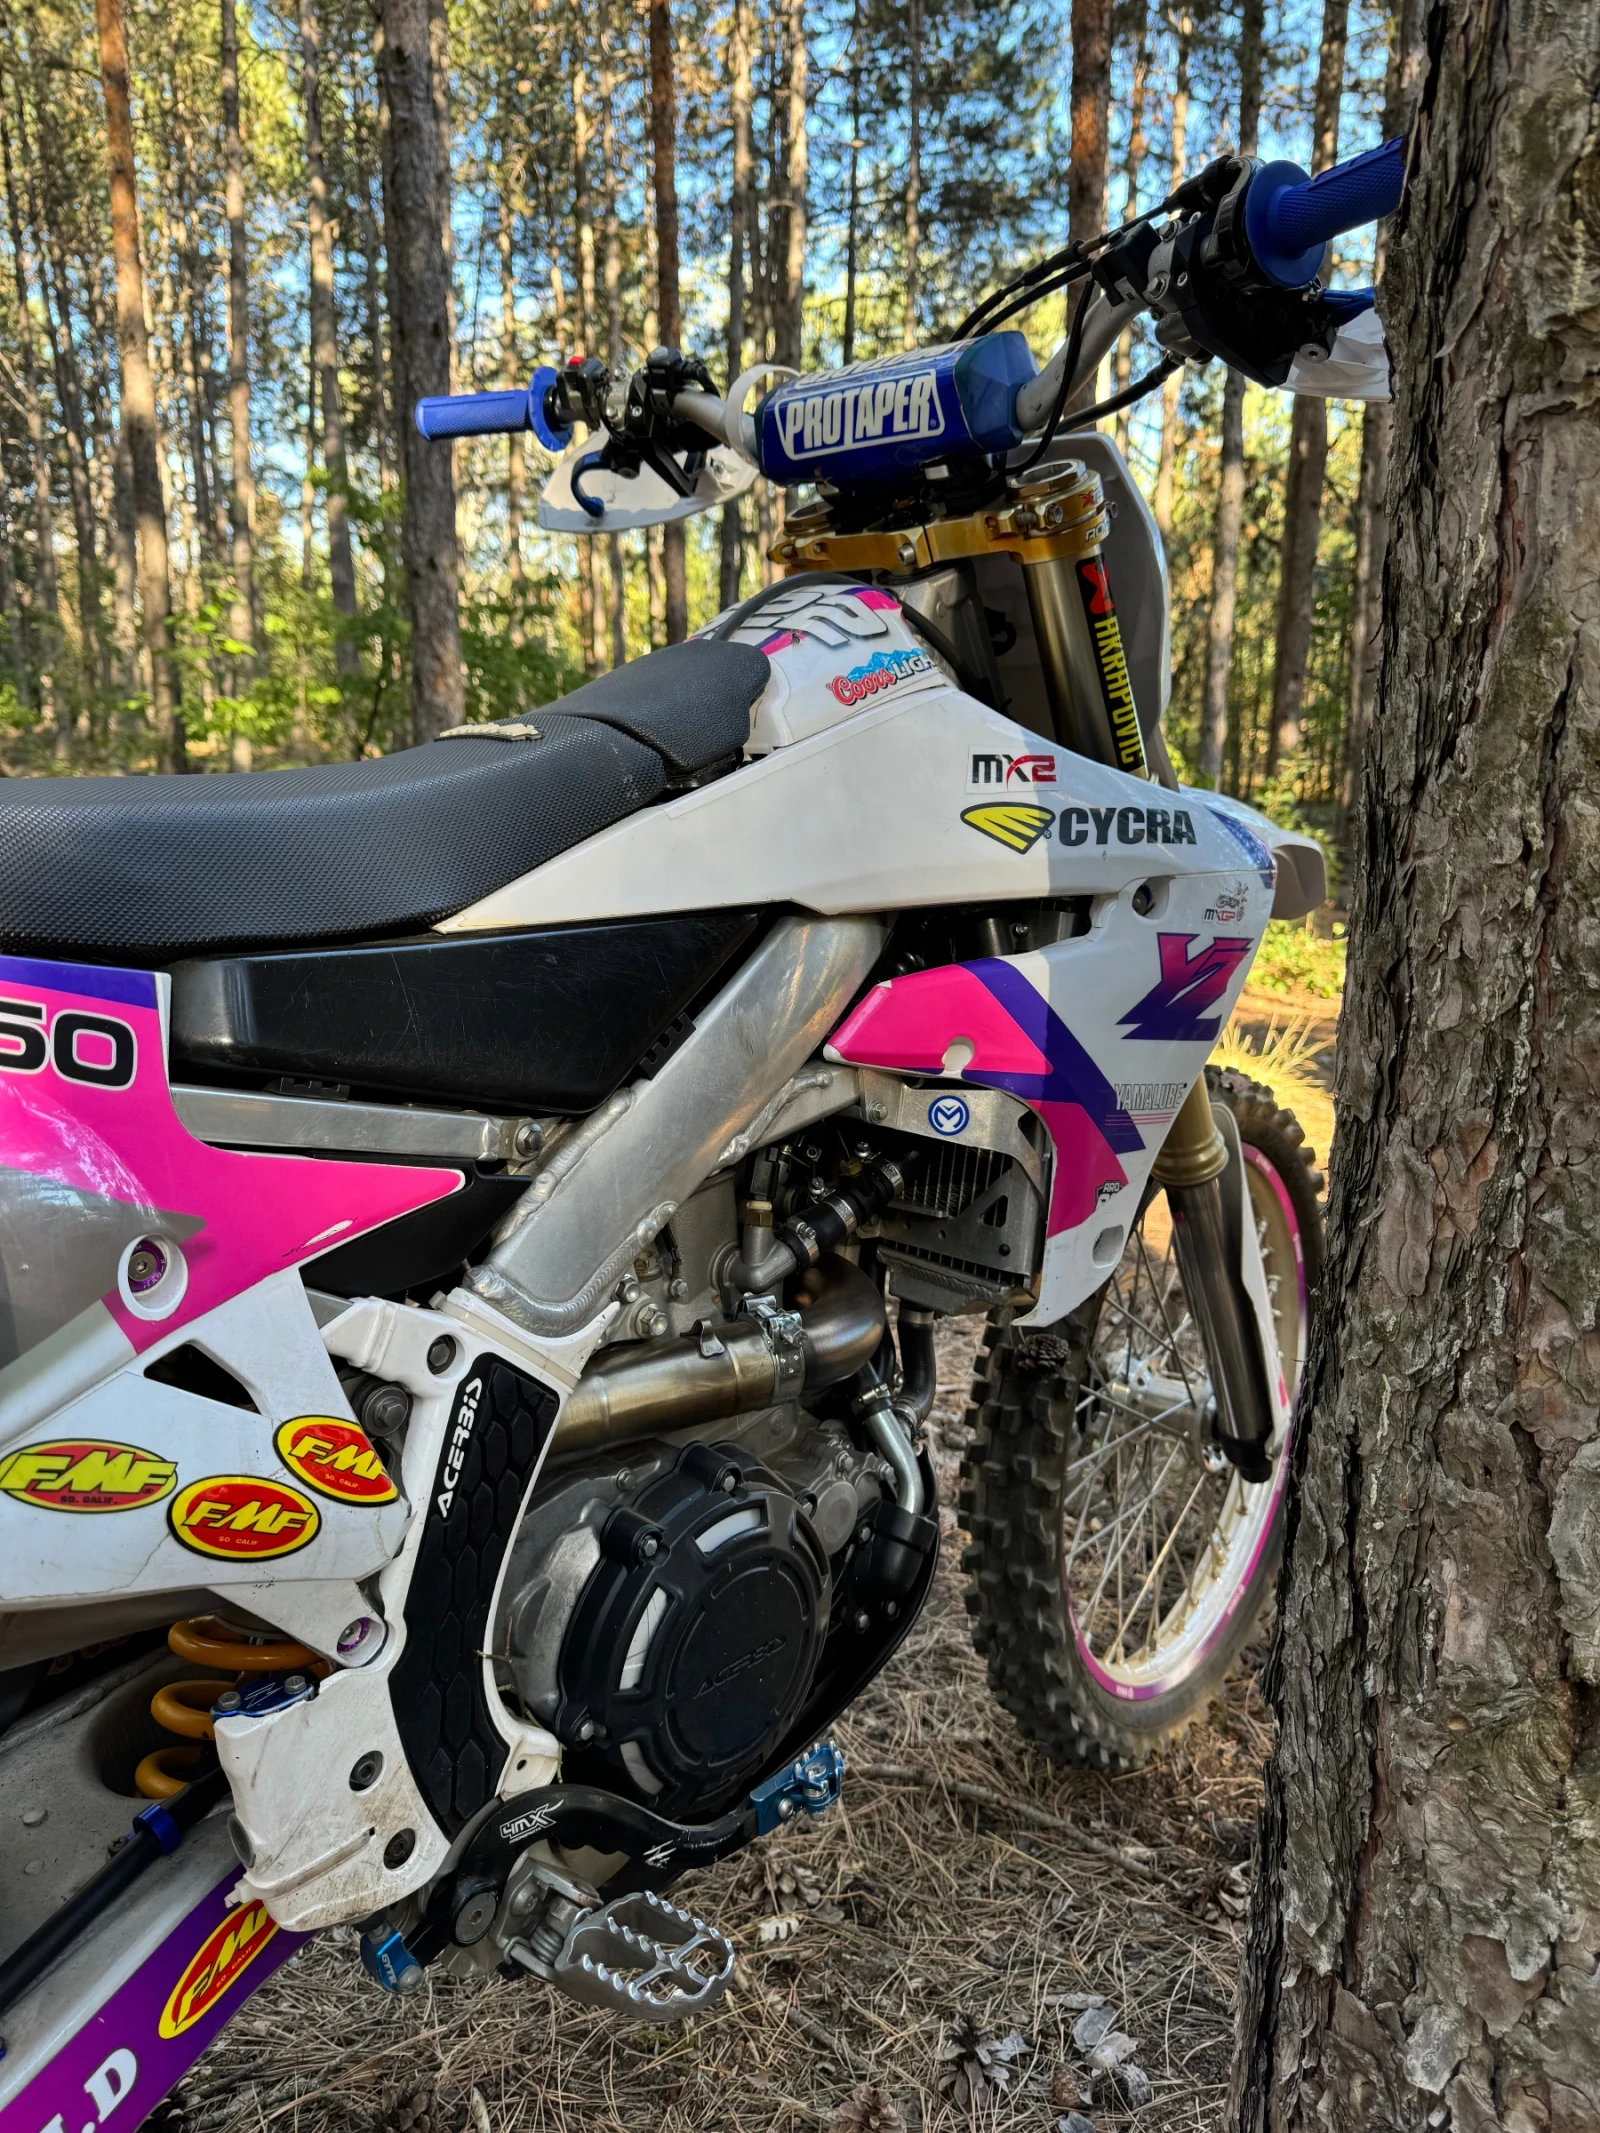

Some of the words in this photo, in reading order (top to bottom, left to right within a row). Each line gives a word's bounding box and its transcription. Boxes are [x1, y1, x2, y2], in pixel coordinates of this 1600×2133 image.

[784, 374, 931, 454] PROTAPER
[826, 666, 896, 705] Coors
[891, 652, 934, 681] LIGH
[971, 754, 1058, 790] MX2
[1058, 806, 1198, 847] CYCRA
[1203, 908, 1237, 922] MXGP
[1114, 1083, 1185, 1111] YAMALUBE
[437, 1377, 482, 1518] ACERBIS
[0, 1449, 179, 1494] FMF
[181, 1499, 314, 1535] FMF
[174, 1905, 268, 2031] FM
